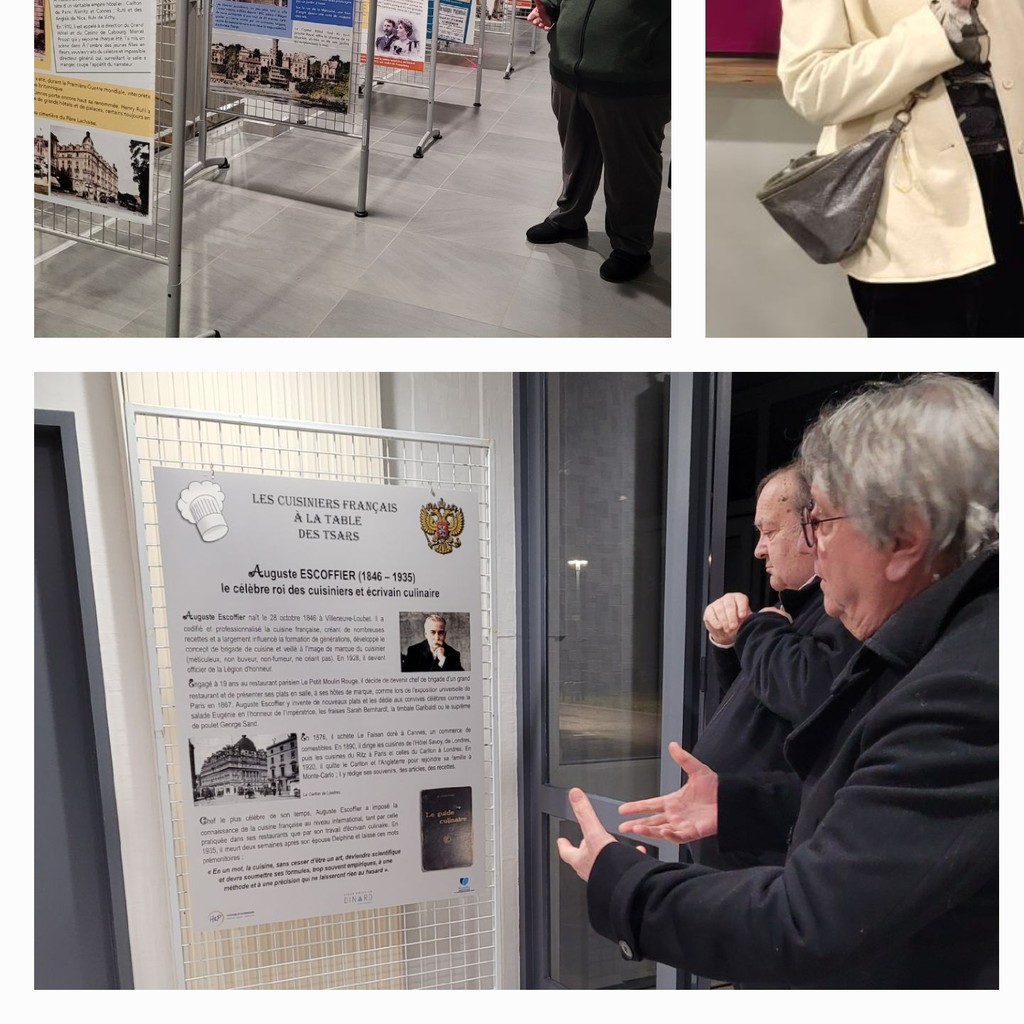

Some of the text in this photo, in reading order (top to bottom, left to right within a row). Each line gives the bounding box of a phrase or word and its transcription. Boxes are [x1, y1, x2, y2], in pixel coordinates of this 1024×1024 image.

[252, 493, 397, 514] LES CUISINIERS FRANÇAIS
[293, 510, 362, 526] À LA TABLE
[298, 528, 359, 541] DES TSARS
[248, 565, 297, 581] Auguste
[299, 568, 356, 580] ESCOFFIER
[358, 570, 382, 583] (1846
[392, 571, 415, 584] 1935)
[220, 582, 440, 598] le célèbre roi des cuisiniers et écrivain culinaire
